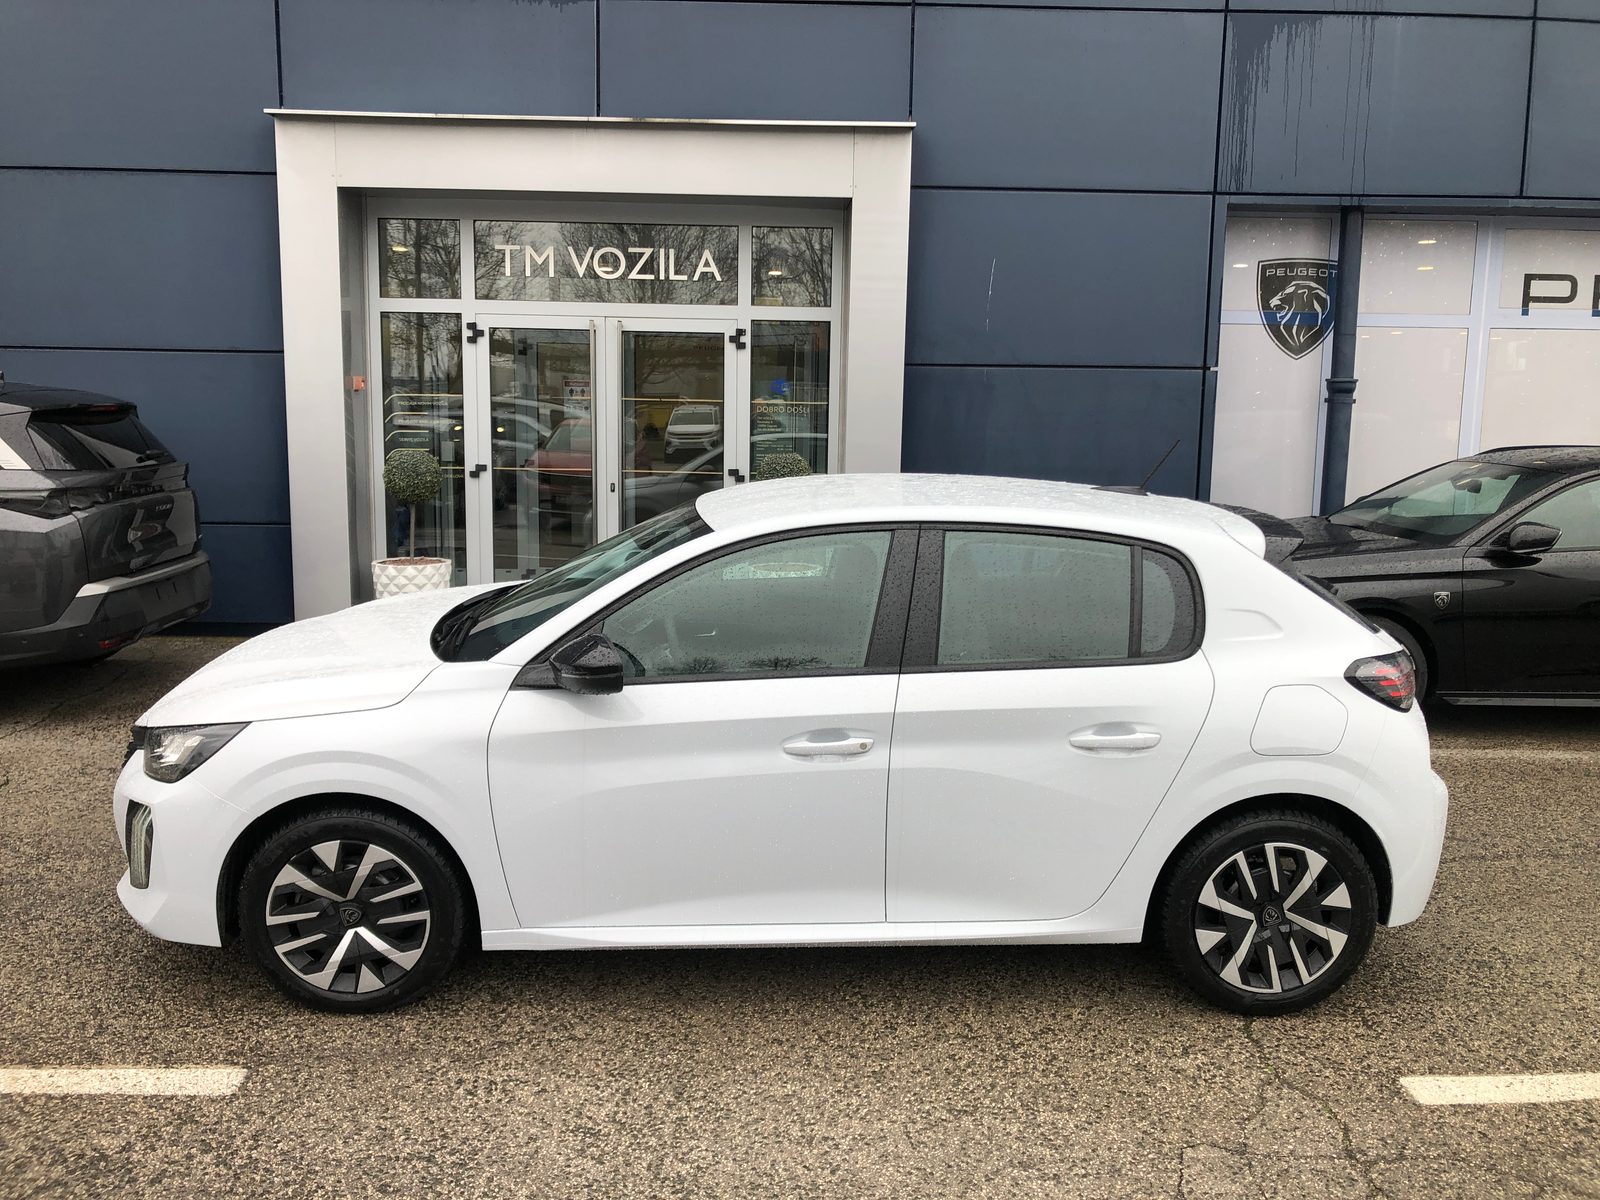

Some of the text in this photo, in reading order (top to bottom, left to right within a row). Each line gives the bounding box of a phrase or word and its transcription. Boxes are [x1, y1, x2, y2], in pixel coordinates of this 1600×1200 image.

[495, 245, 722, 281] TM VOZILA
[1266, 267, 1338, 278] PEUGEOT
[1521, 273, 1600, 317] P
[756, 405, 785, 413] DOBRO
